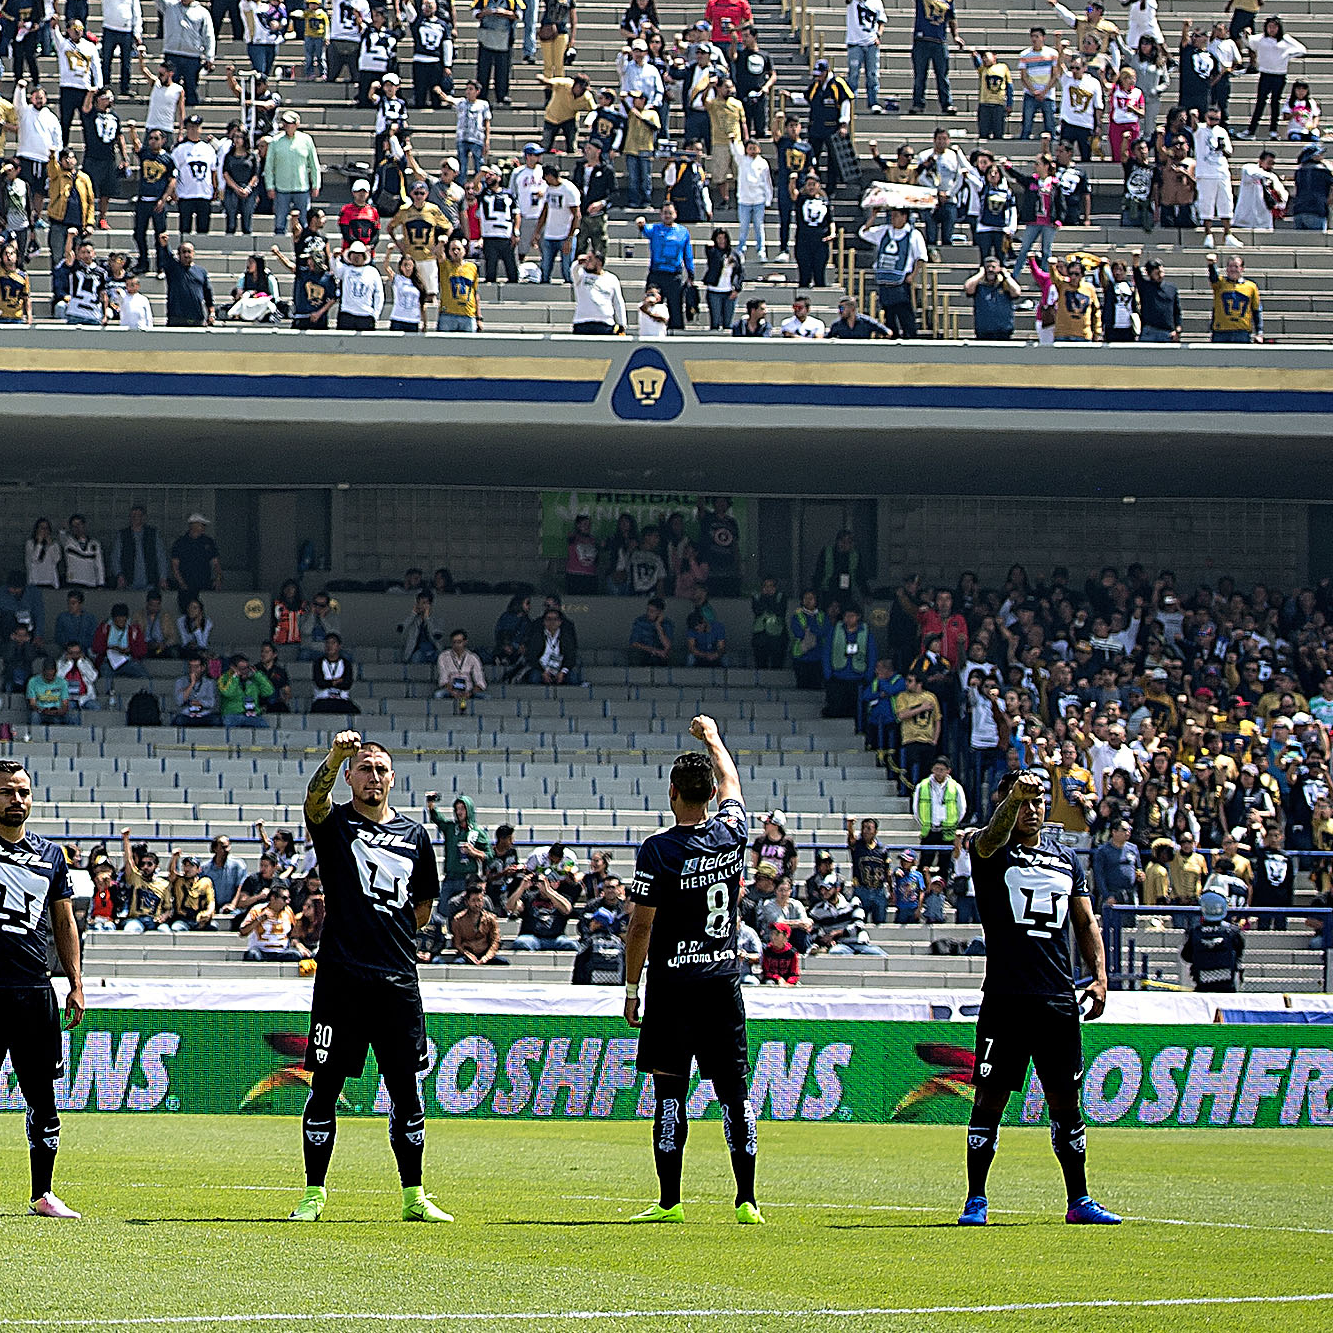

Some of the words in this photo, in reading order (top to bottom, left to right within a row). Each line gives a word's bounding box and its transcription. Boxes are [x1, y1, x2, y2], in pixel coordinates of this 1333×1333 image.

[357, 829, 416, 850] DHL
[705, 882, 730, 938] 8
[314, 1023, 333, 1047] 30
[984, 1038, 994, 1060] 7
